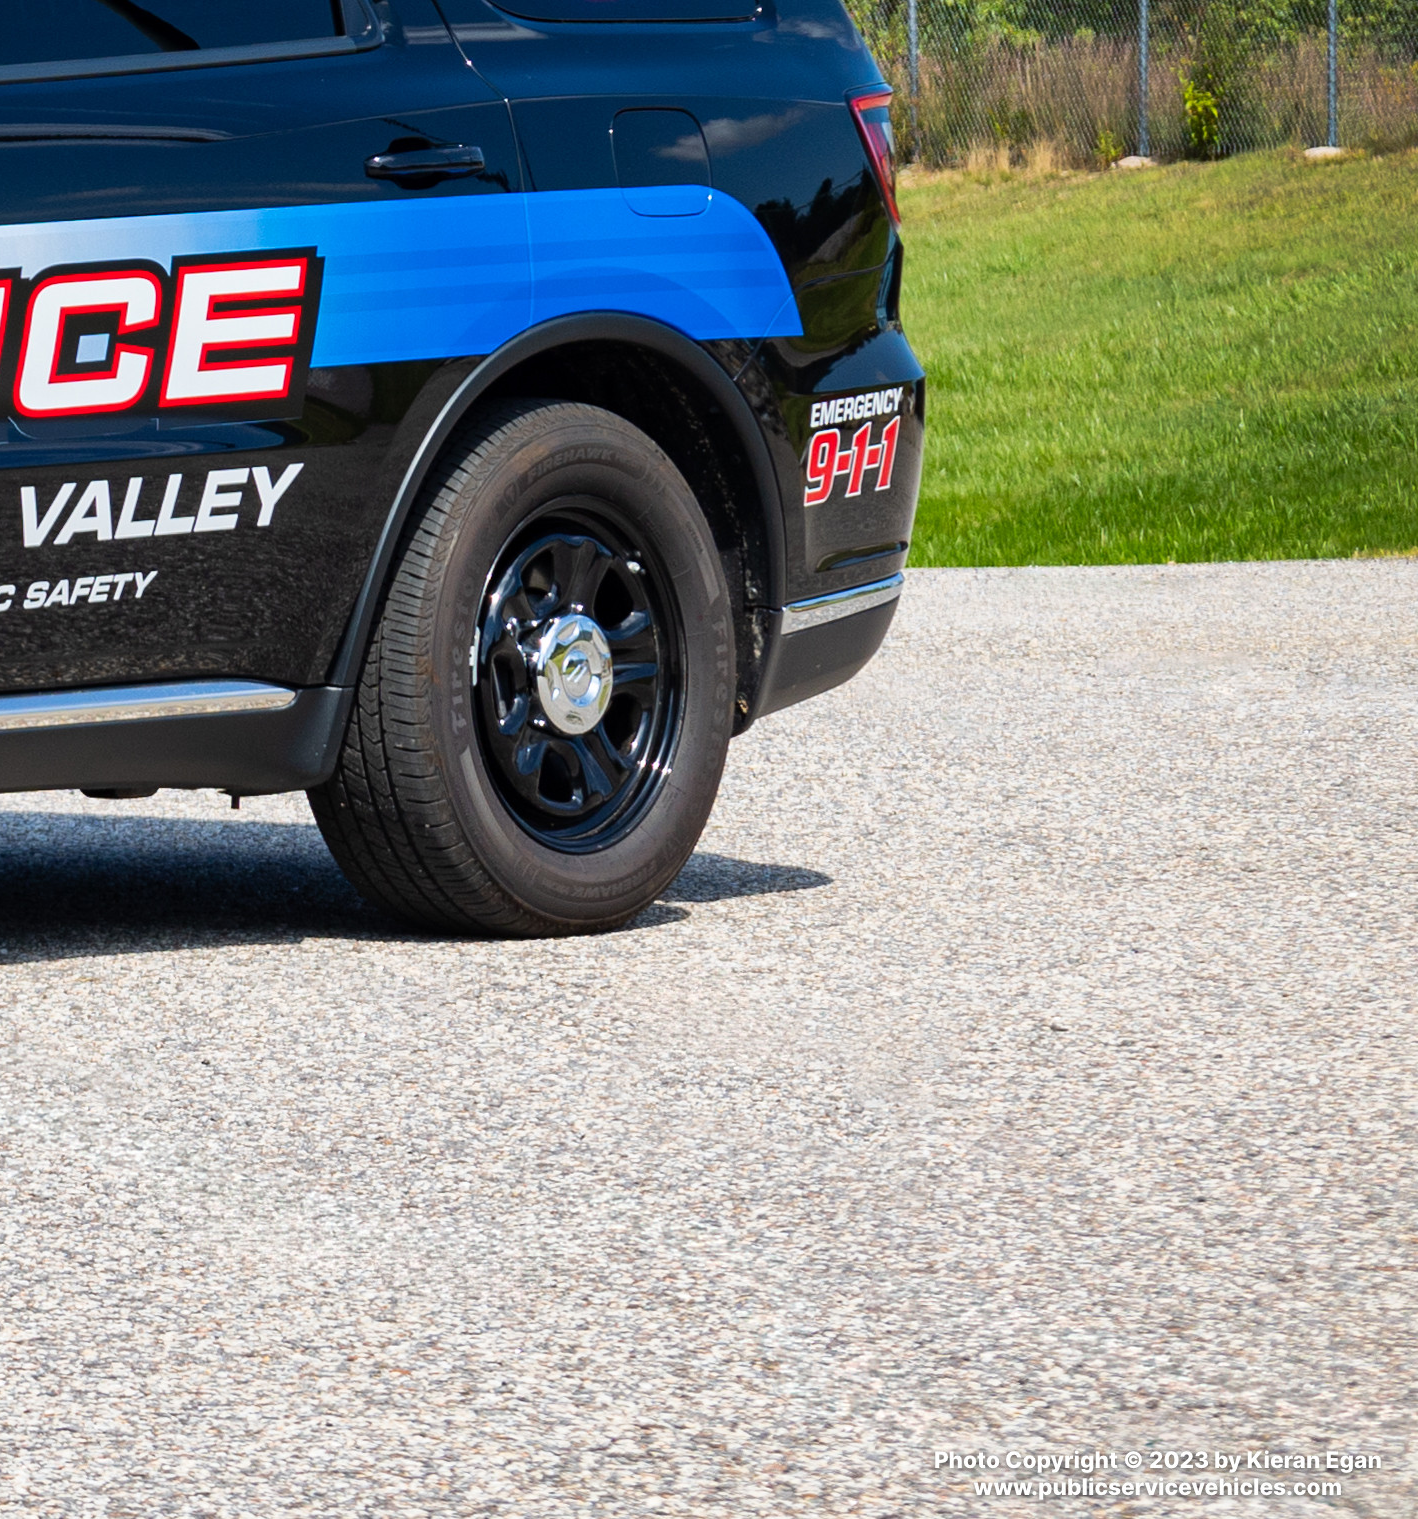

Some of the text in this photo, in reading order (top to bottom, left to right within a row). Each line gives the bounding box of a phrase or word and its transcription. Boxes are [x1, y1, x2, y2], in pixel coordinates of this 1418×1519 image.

[809, 386, 904, 428] EMERGENCY
[803, 414, 901, 507] 9-1-1
[19, 461, 304, 548] VALLEY
[22, 570, 158, 611] SAFETY
